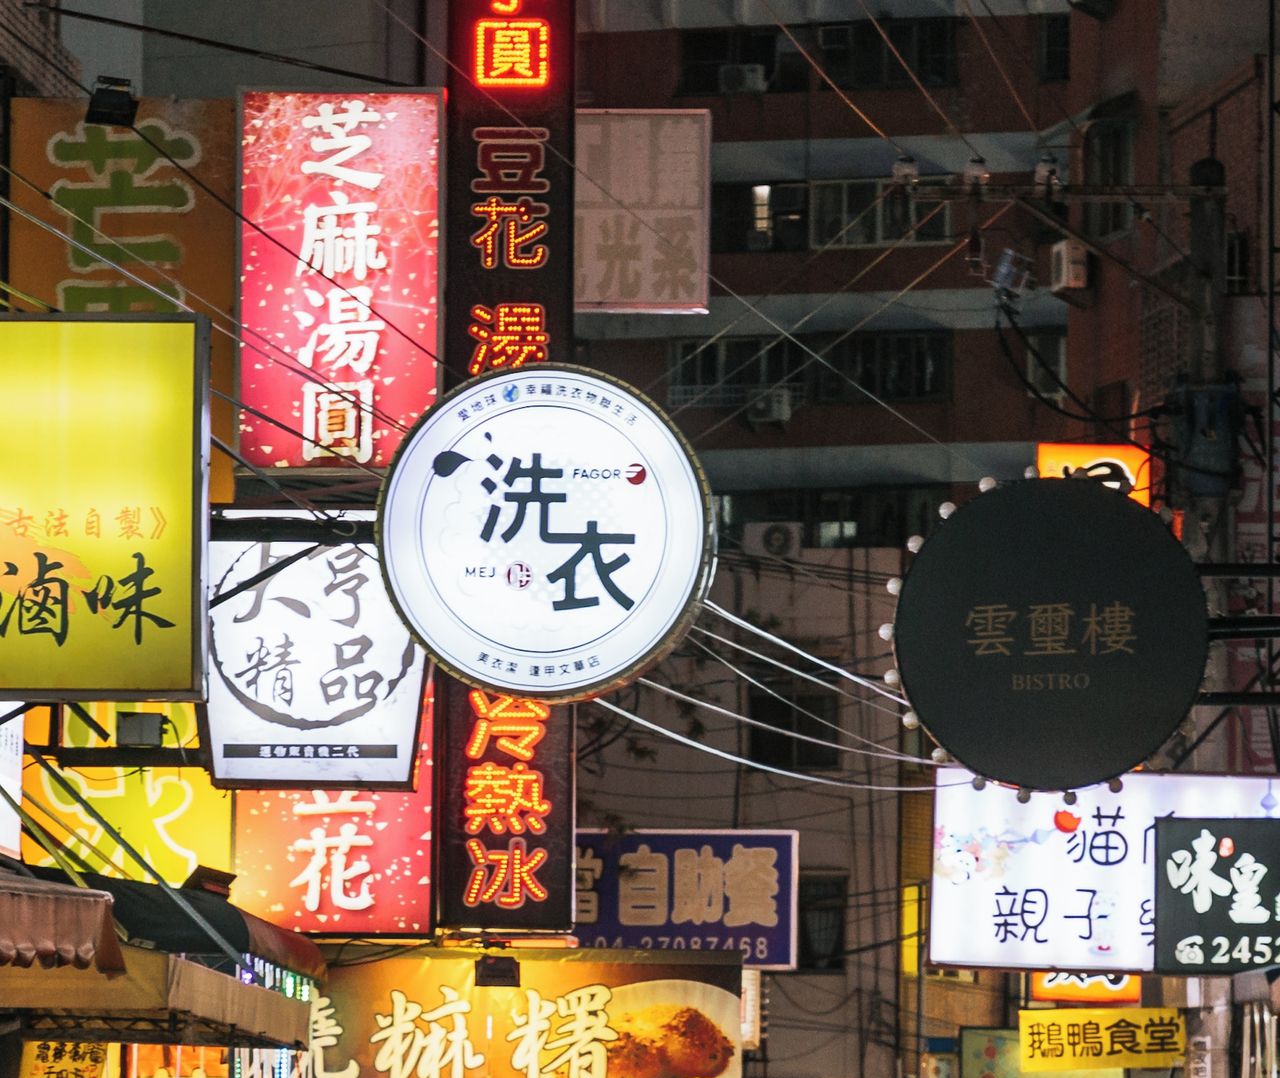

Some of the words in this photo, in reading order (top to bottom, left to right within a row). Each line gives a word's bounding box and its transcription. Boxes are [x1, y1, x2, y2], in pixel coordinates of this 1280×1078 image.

[298, 100, 388, 463] 芝麻湯圓
[572, 468, 622, 480] FAGOR
[480, 453, 636, 612] 洗衣
[465, 567, 497, 578] MEJ
[236, 633, 383, 707] 精品
[1011, 672, 1091, 691] BISTRO
[464, 689, 550, 910] 冷熱冰
[1027, 1017, 1181, 1060] 鵝鴨食堂
